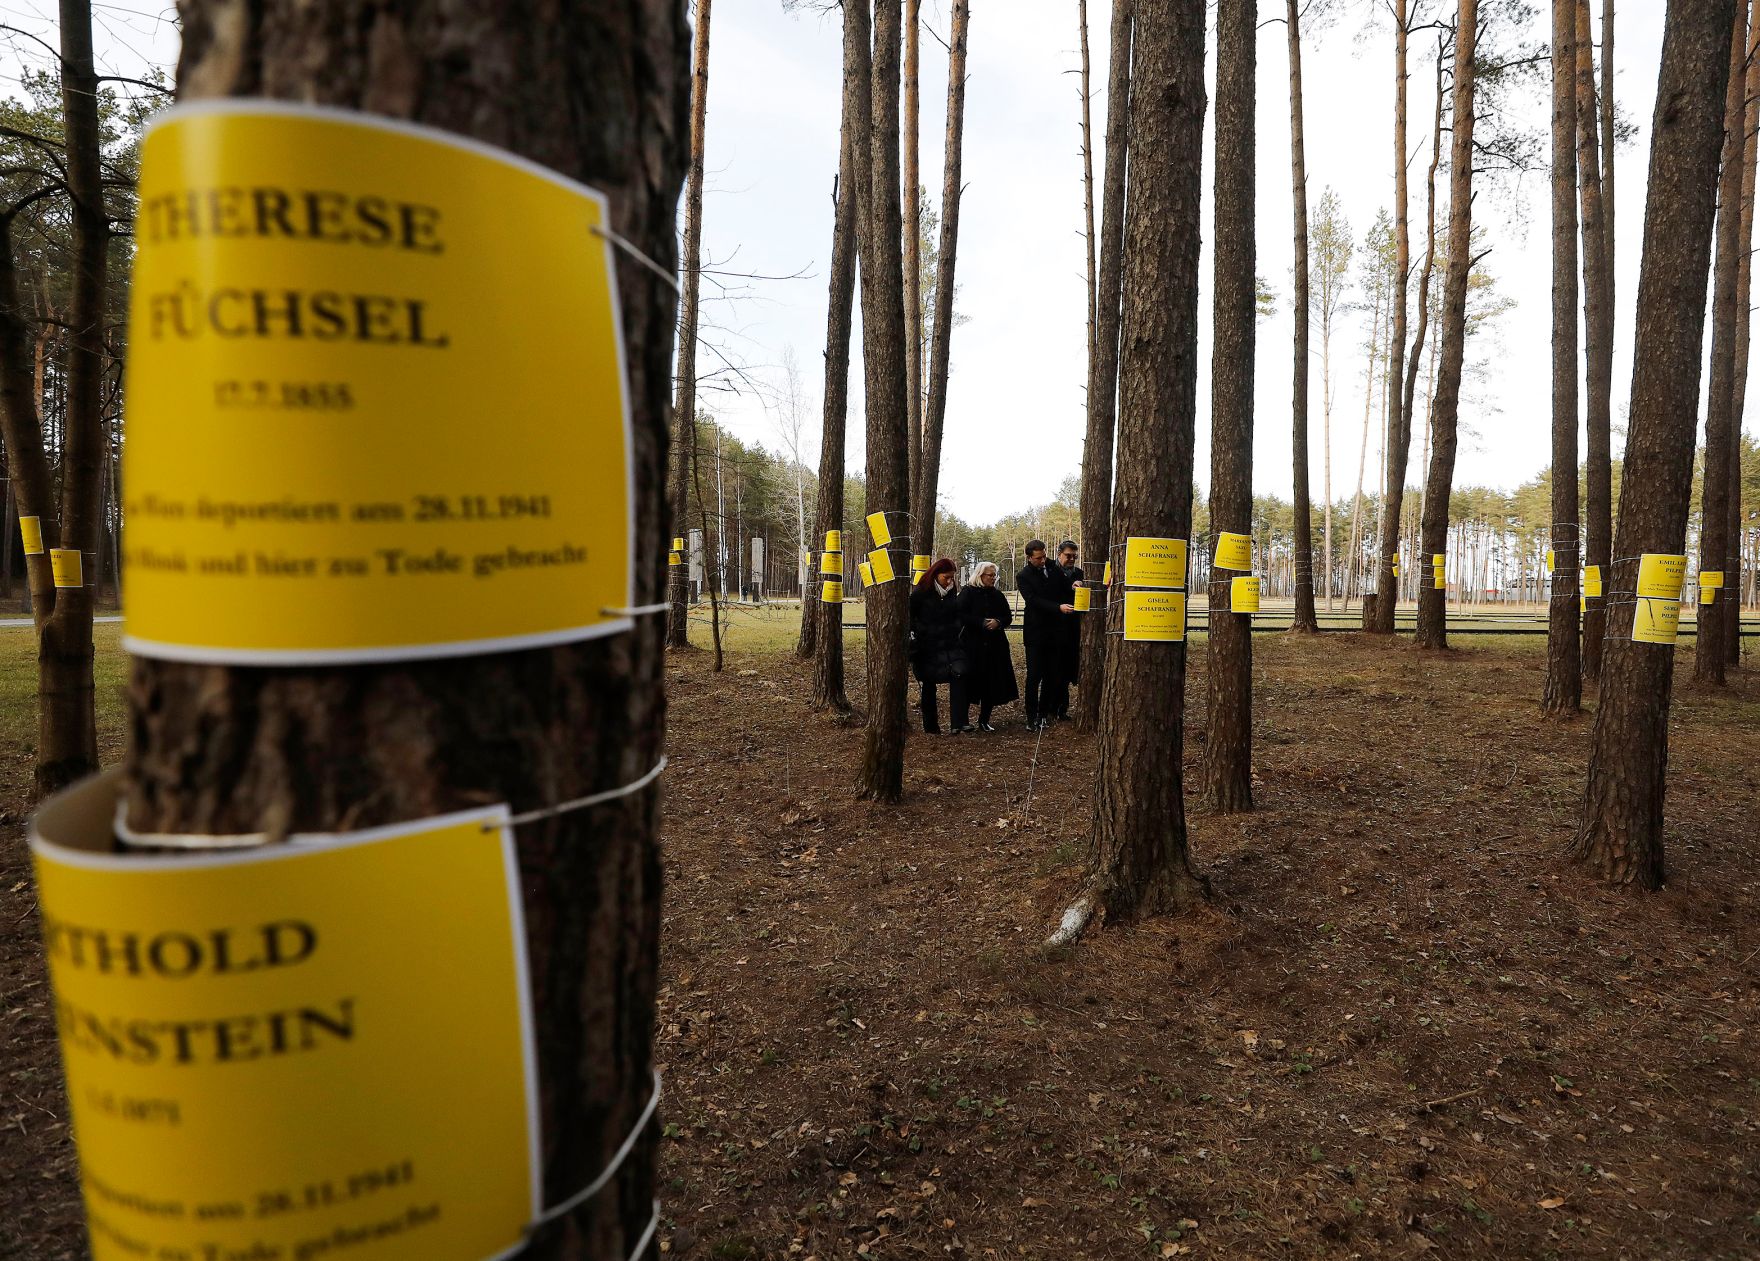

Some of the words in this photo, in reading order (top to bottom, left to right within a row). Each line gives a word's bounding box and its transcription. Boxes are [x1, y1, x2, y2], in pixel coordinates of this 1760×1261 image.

[147, 186, 445, 255] THERESE
[150, 279, 450, 348] FÜCHSEL
[412, 494, 551, 521] 28.11.1941
[375, 547, 463, 575] Tode
[473, 541, 588, 578] gebracht
